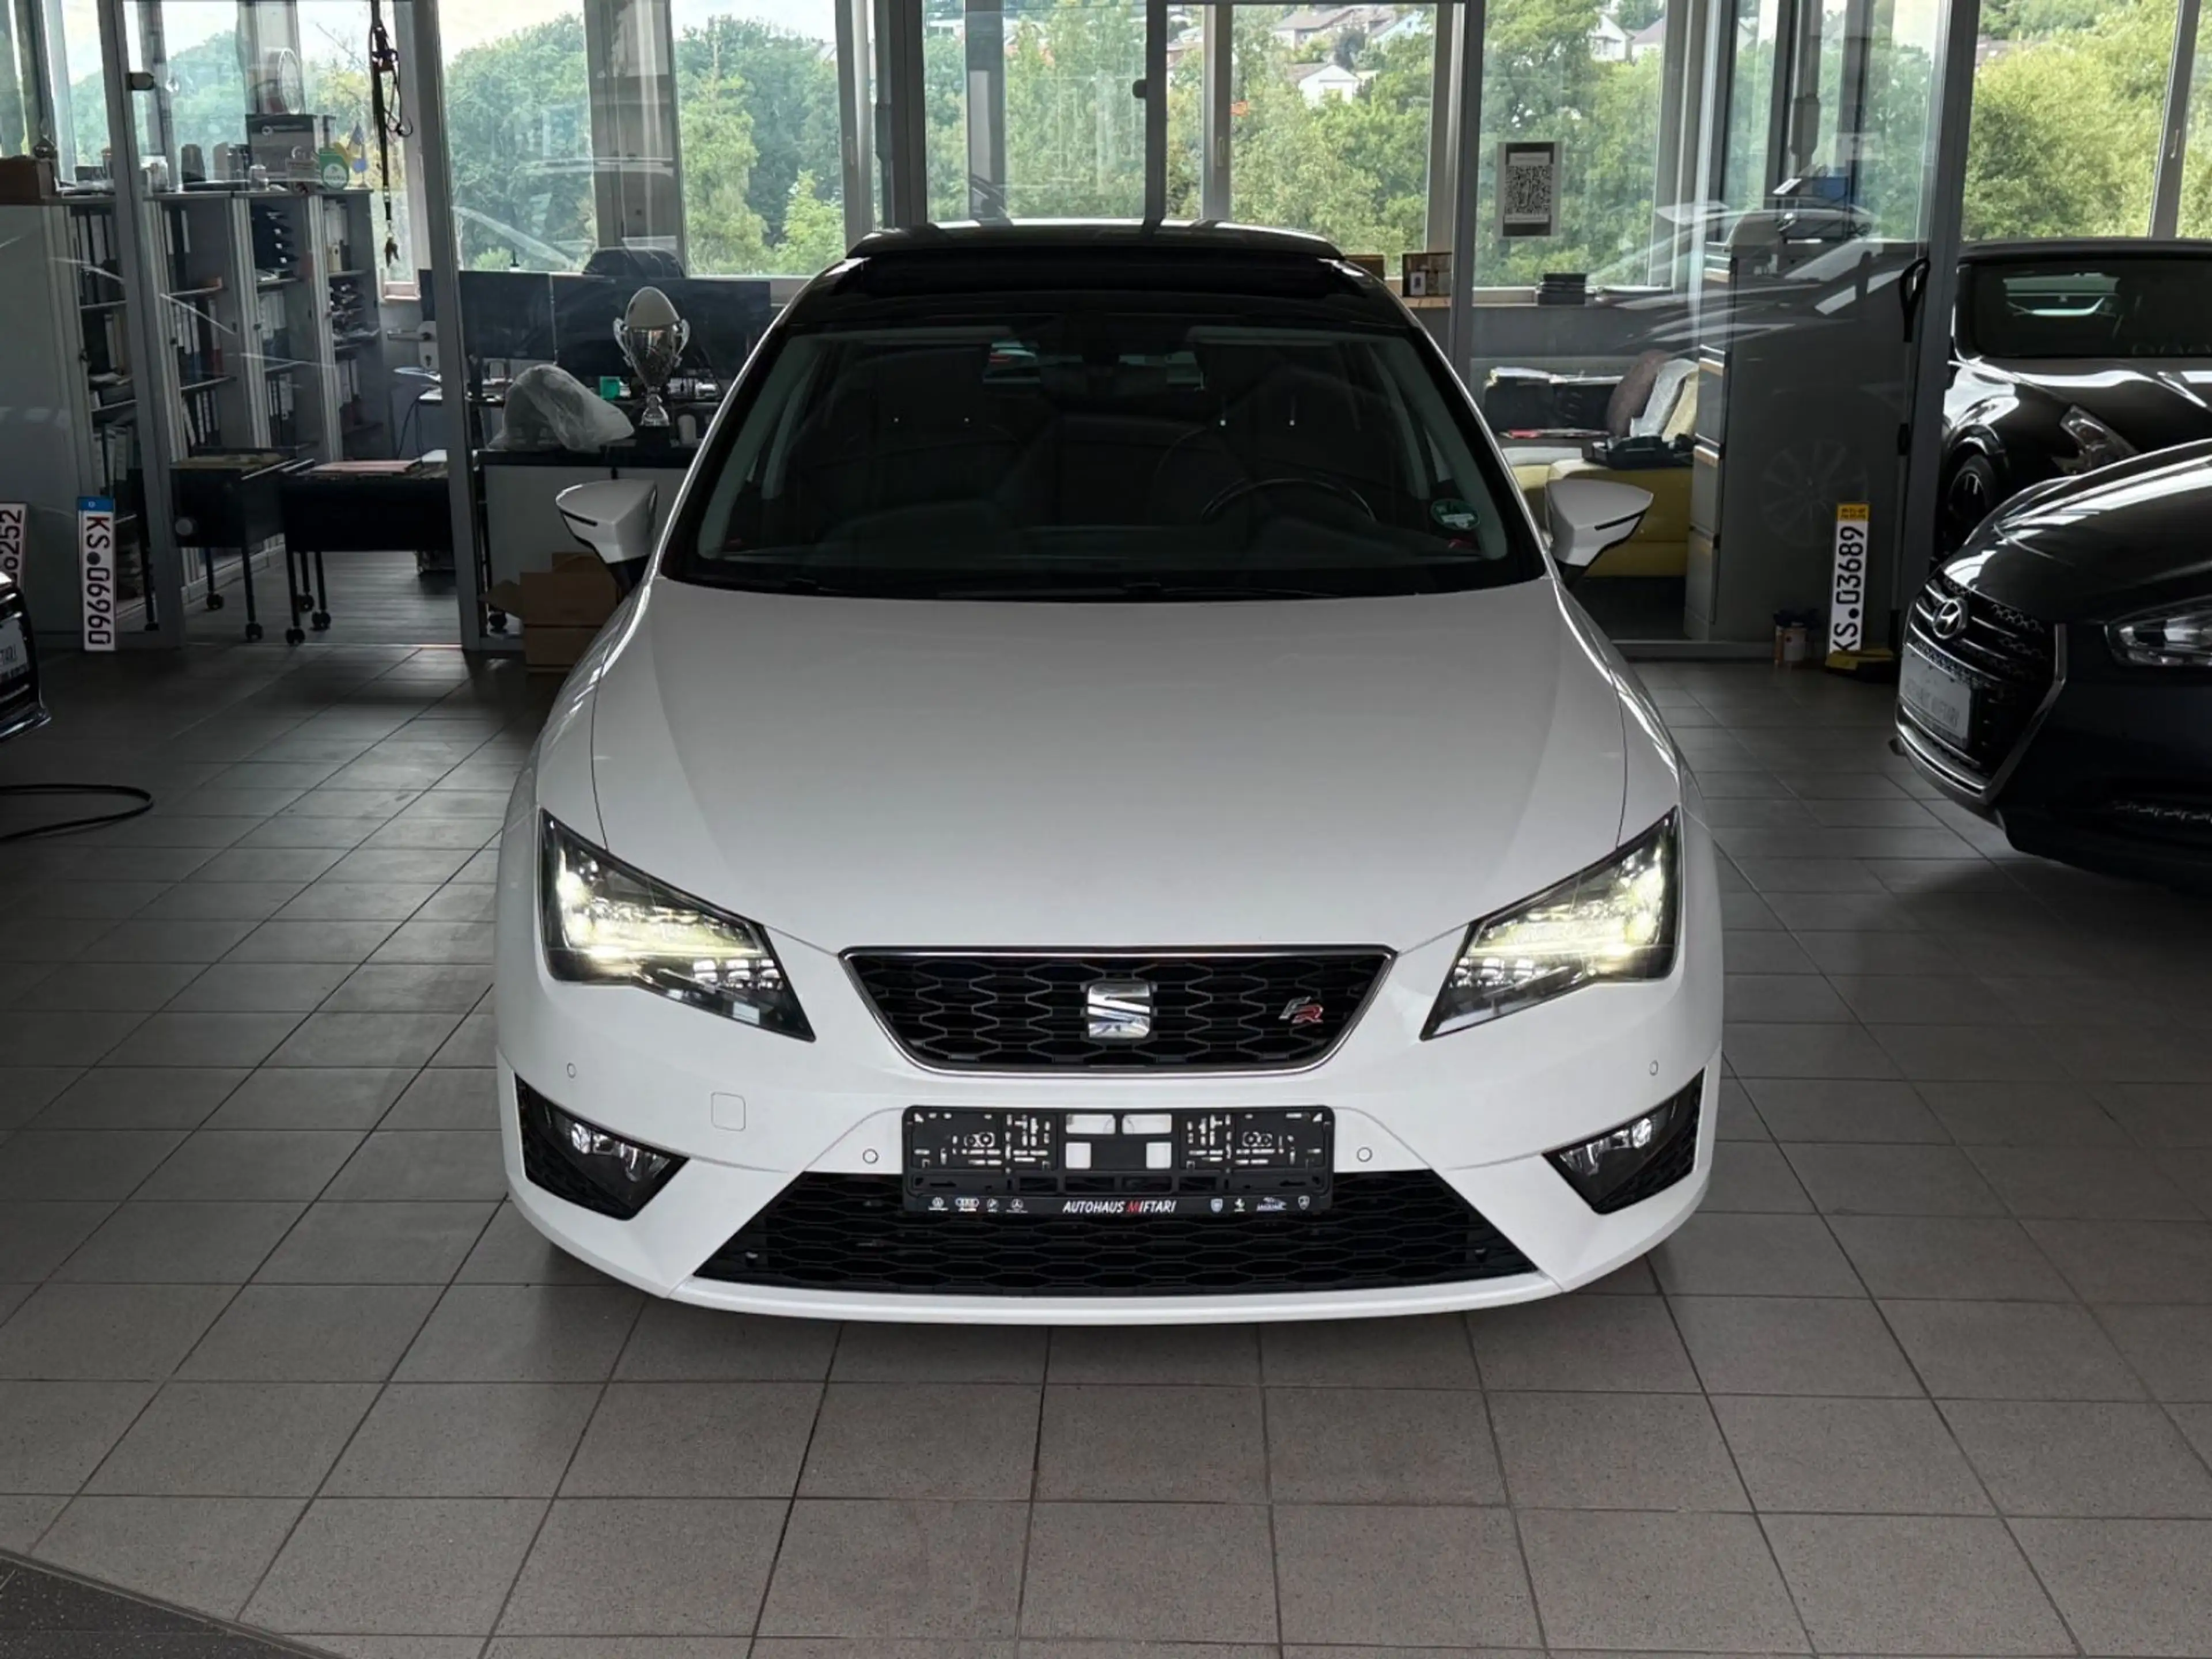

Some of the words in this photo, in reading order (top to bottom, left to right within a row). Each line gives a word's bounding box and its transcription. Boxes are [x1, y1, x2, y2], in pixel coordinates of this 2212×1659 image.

[86, 517, 110, 548] KS
[1836, 526, 1865, 604] 03689
[87, 567, 111, 645] 06960
[1278, 995, 1324, 1024] FR
[1062, 1200, 1125, 1214] AUTOHAUS
[1127, 1200, 1177, 1214] MIFTARI
